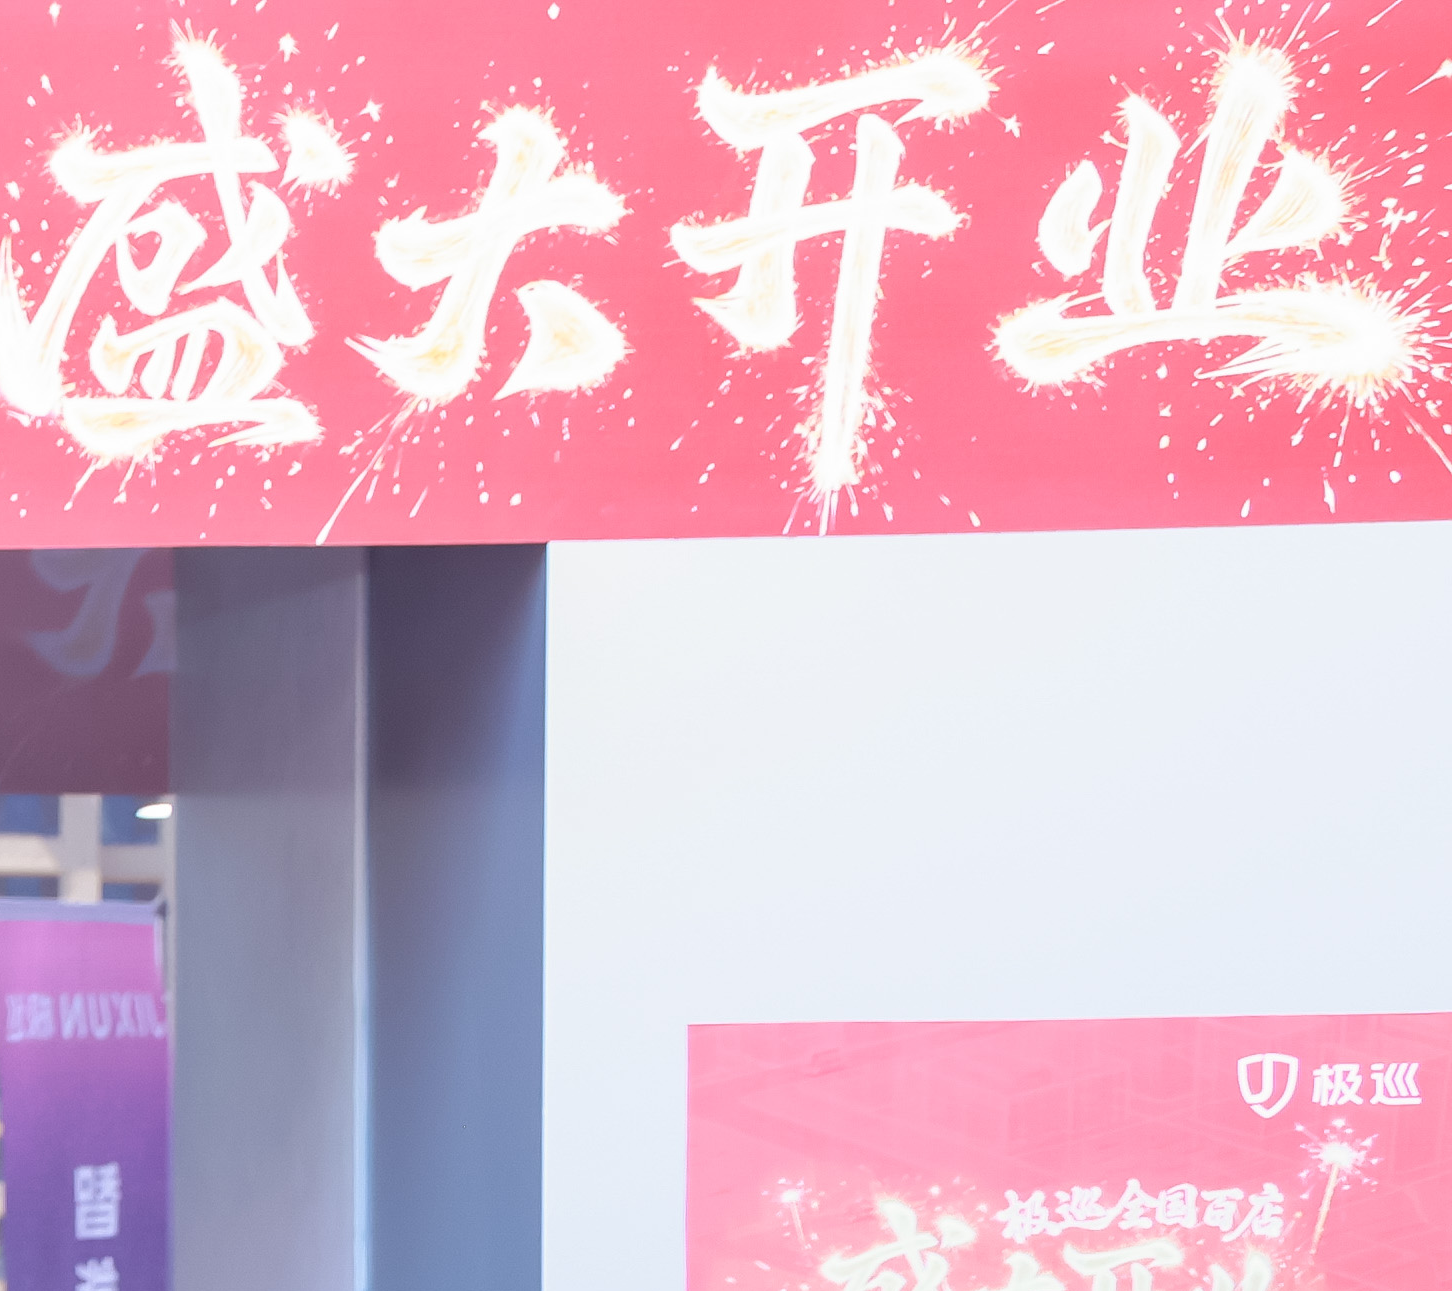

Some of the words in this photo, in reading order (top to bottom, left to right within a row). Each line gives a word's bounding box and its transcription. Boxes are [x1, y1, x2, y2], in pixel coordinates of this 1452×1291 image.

[1312, 1062, 1422, 1107] 极巡
[995, 1178, 1287, 1245] 极巡全国百店
